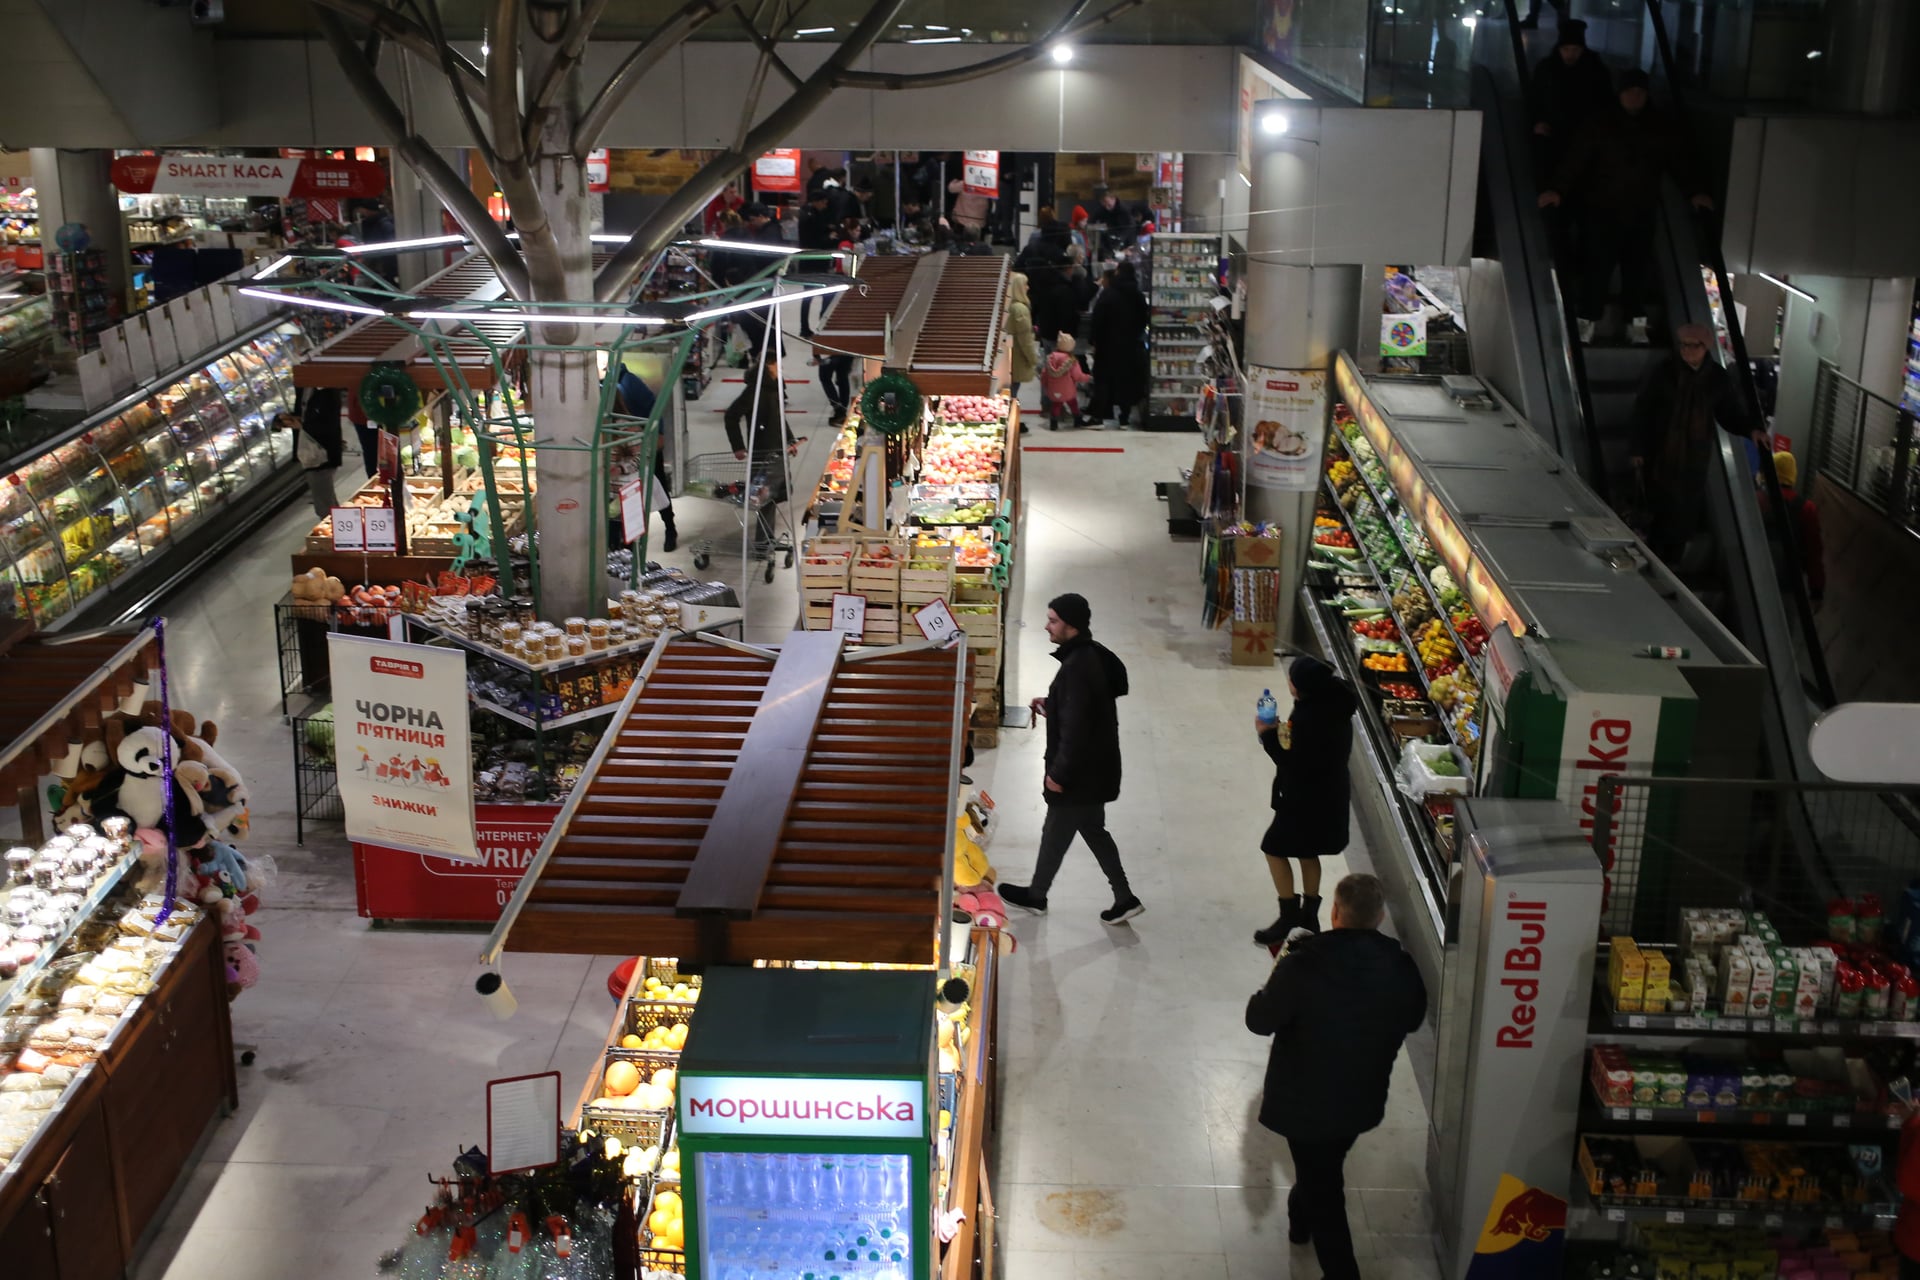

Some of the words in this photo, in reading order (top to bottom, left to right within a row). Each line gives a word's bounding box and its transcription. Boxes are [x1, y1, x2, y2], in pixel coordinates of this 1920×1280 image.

[168, 163, 227, 178] SMART
[233, 164, 283, 179] КАСА
[338, 520, 353, 532] 39
[371, 520, 386, 532] 59
[840, 608, 855, 620] 13
[928, 616, 944, 632] 19
[356, 699, 443, 730] ЧОРНА
[357, 721, 445, 748] П'ЯТНИЦЯ
[372, 795, 437, 817] ЗНИЖКИ
[1504, 902, 1547, 971] Bull
[1496, 978, 1539, 1048] Red
[690, 1094, 914, 1123] моршинська
